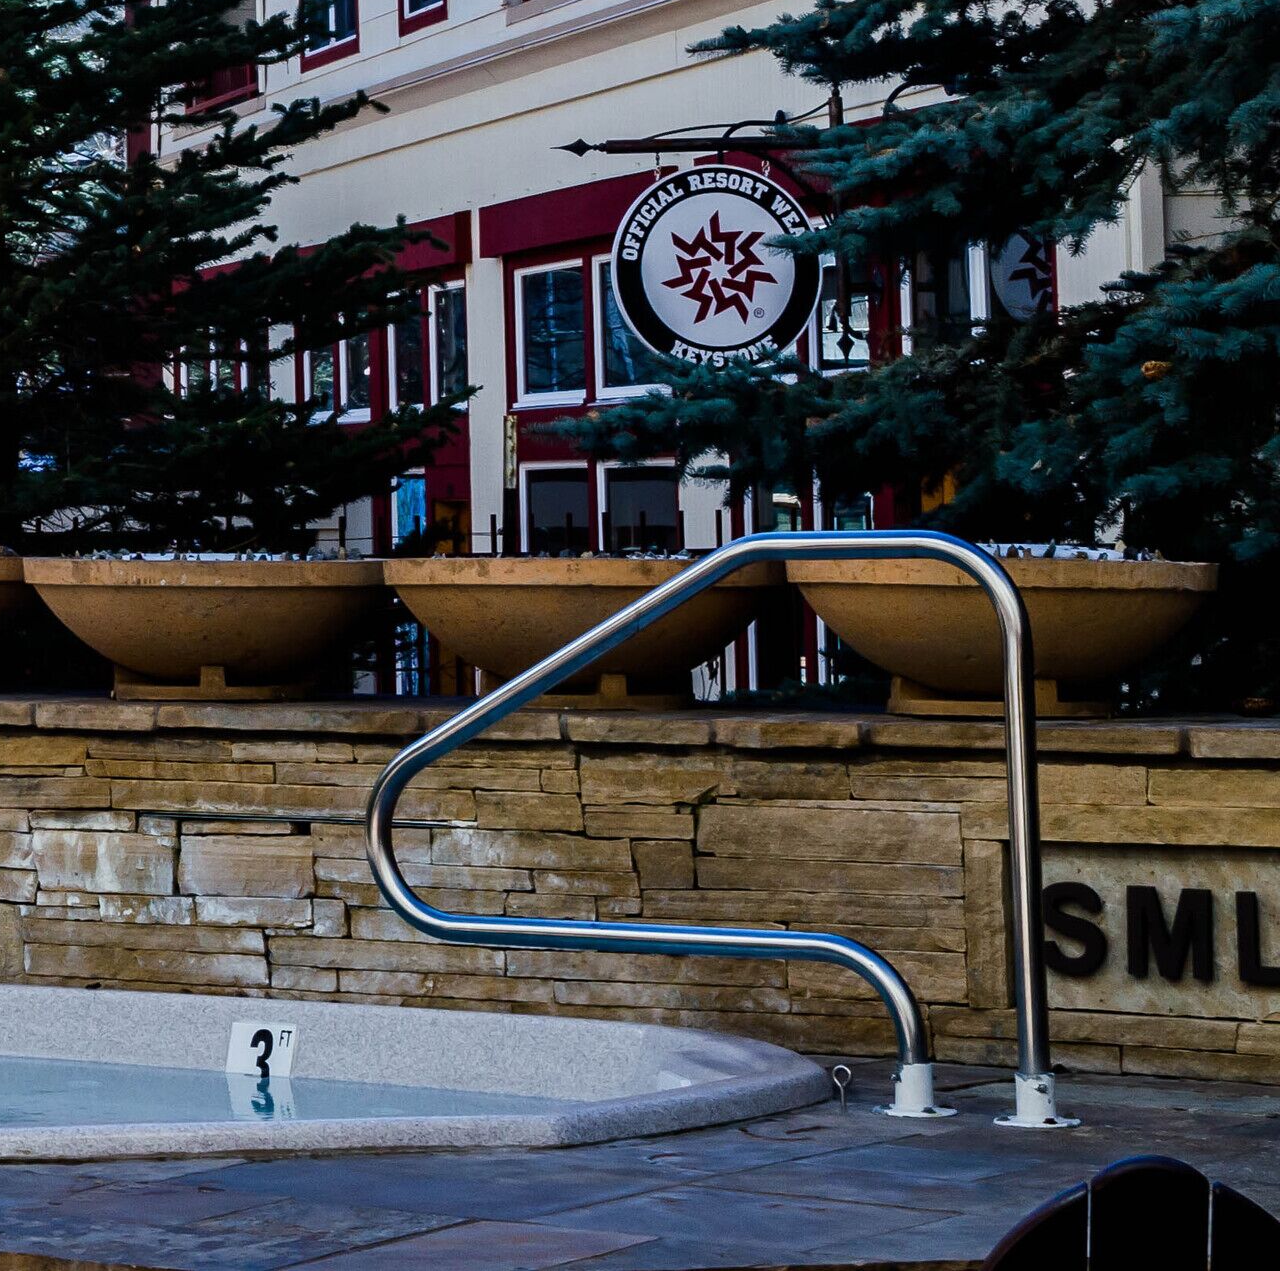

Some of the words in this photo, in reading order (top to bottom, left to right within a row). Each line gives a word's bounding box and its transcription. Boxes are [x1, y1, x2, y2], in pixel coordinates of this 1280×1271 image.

[622, 183, 685, 261] OFFICIAL
[687, 172, 769, 199] RESORT
[771, 195, 806, 237] WEA
[1042, 882, 1280, 985] SML
[279, 1030, 293, 1047] FT
